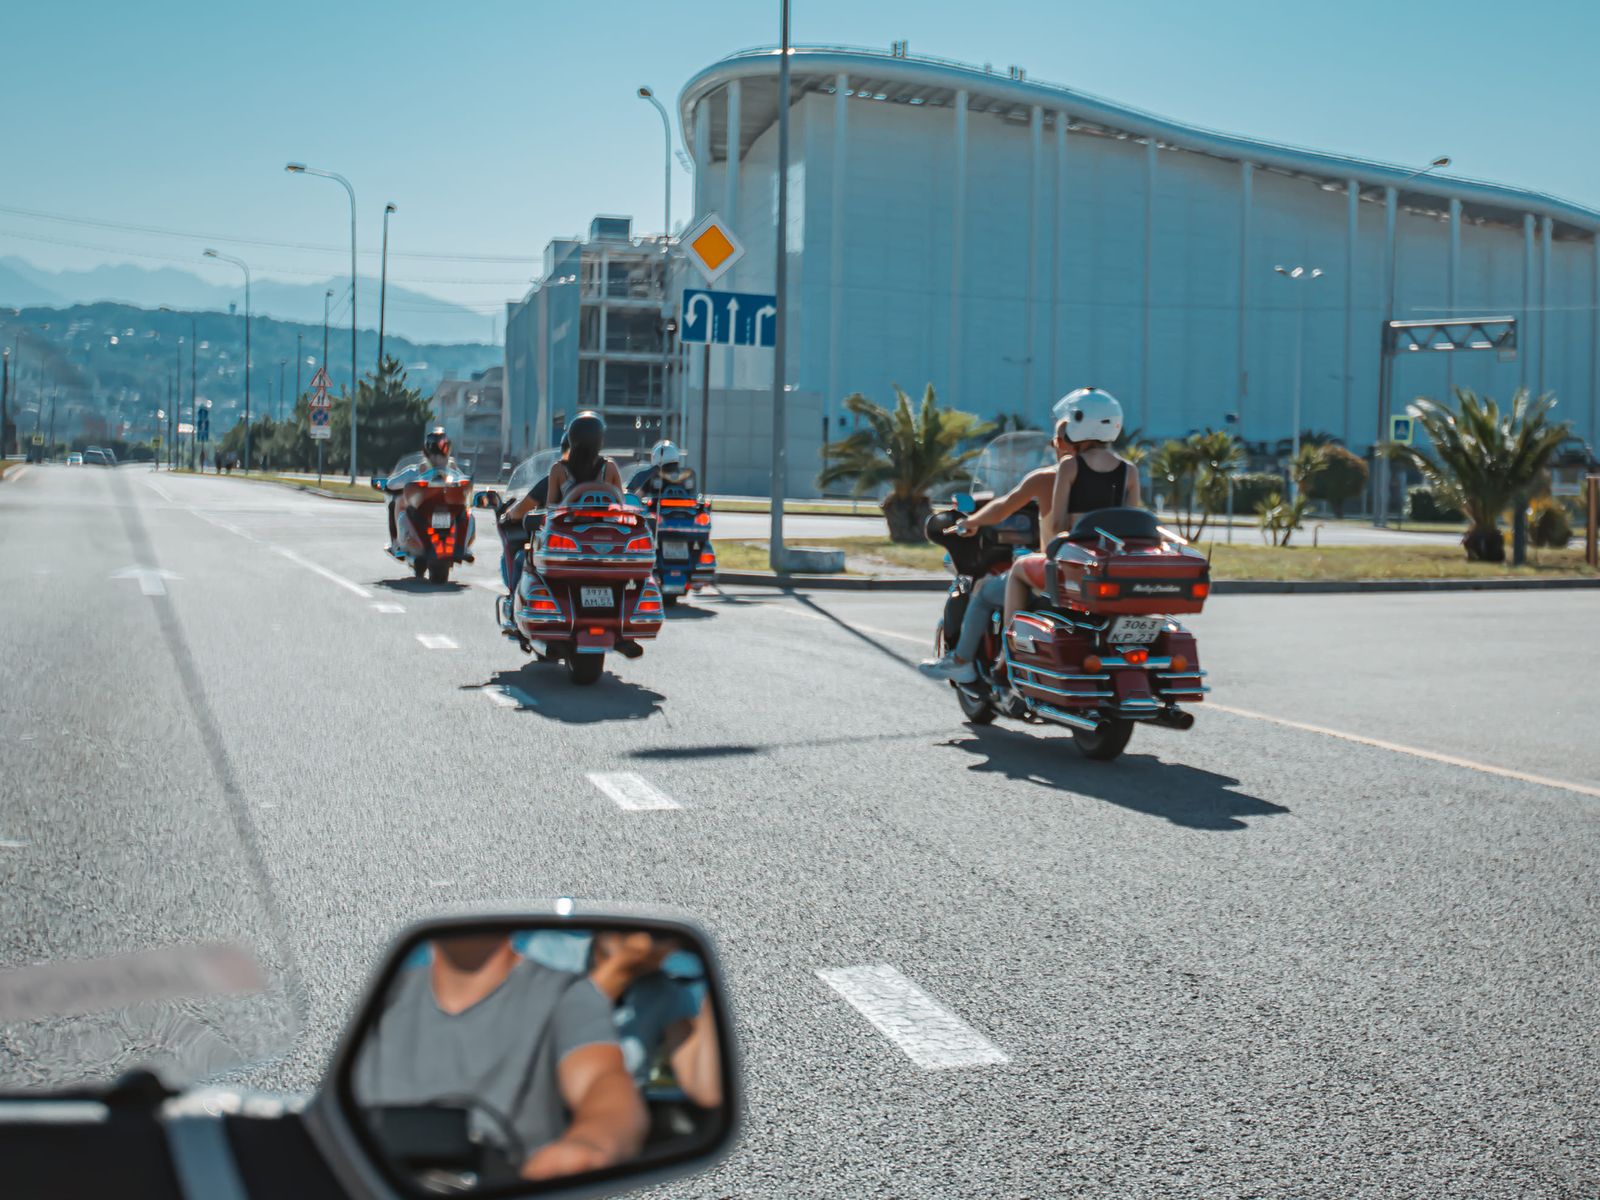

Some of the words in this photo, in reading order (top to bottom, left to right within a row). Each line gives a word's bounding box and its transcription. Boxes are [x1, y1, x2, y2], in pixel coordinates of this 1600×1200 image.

[1121, 620, 1158, 630] 3063
[1110, 633, 1133, 642] KP
[1136, 633, 1155, 642] 23
